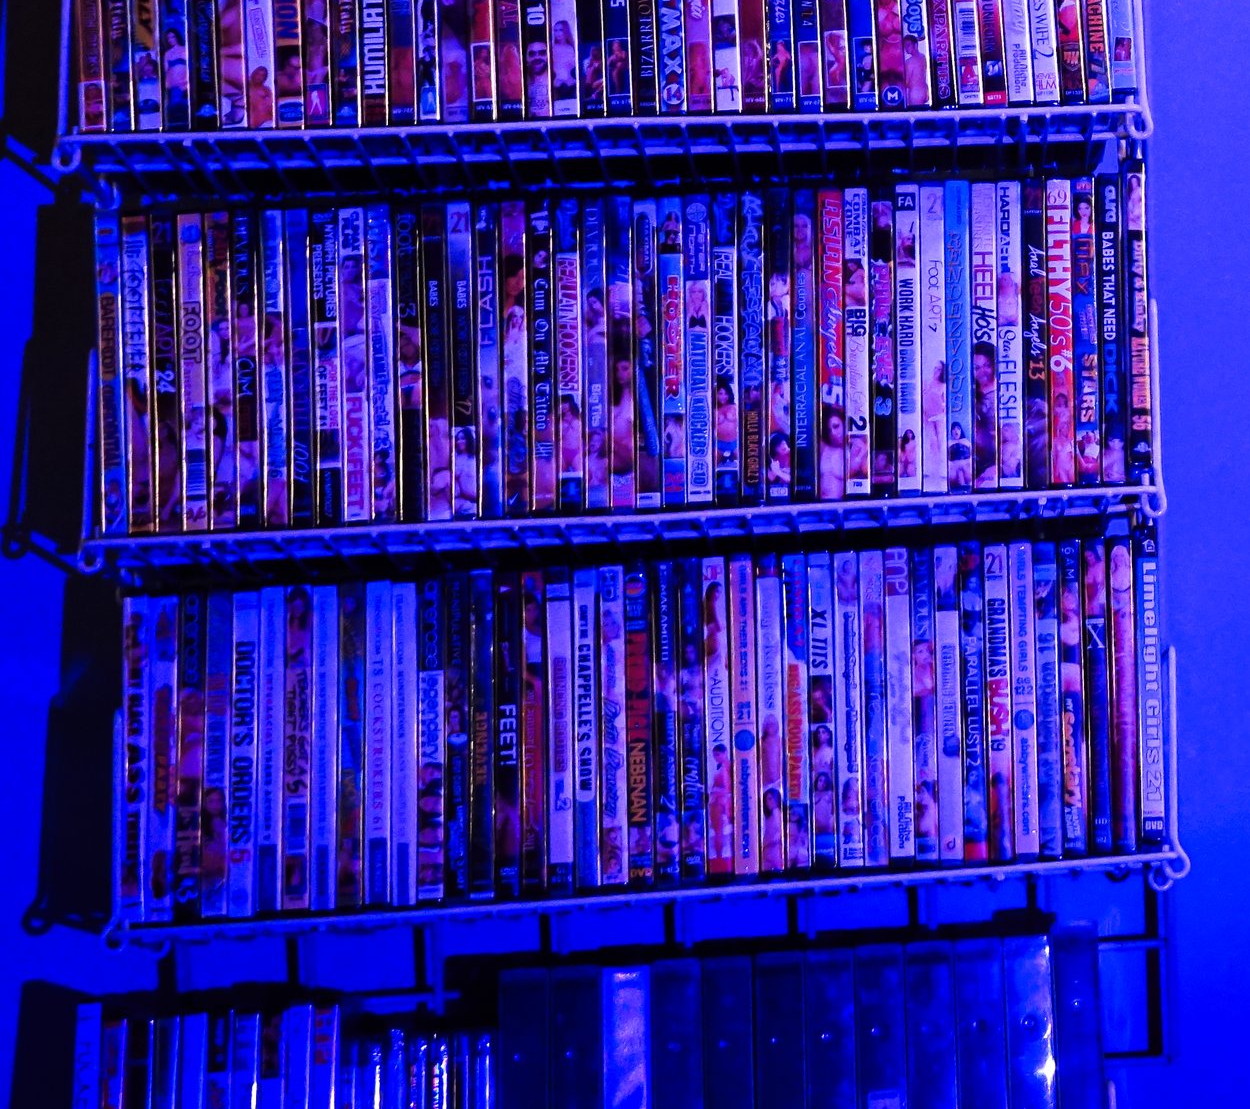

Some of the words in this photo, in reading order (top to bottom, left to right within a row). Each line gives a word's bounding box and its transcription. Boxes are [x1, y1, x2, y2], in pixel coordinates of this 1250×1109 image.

[527, 4, 545, 25] 10
[1048, 210, 1070, 299] FILTHY
[1102, 232, 1114, 273] BABES
[534, 278, 549, 311] Cum
[899, 278, 913, 312] WORK
[1103, 276, 1115, 305] THAT
[534, 318, 549, 341] On
[899, 316, 914, 347] HARD
[1049, 299, 1072, 345] 50's
[1103, 309, 1116, 340] NEED
[533, 350, 550, 374] My
[1050, 349, 1071, 372] #6
[346, 397, 363, 449] FUCK
[534, 383, 550, 430] Tattoo
[347, 456, 364, 508] FEET
[810, 609, 828, 636] XL
[988, 598, 1006, 677] GRANDMA'S
[1142, 562, 1160, 692] Limelight
[811, 637, 829, 669] TITS
[232, 641, 256, 747] DOCTOR'S
[988, 678, 1009, 737] BUSH
[499, 705, 517, 766] FEET!
[990, 738, 1006, 751] 19
[1144, 699, 1161, 765] Girls
[231, 757, 253, 844] ORDERS
[1146, 771, 1163, 802] 21
[230, 848, 251, 864] 5
